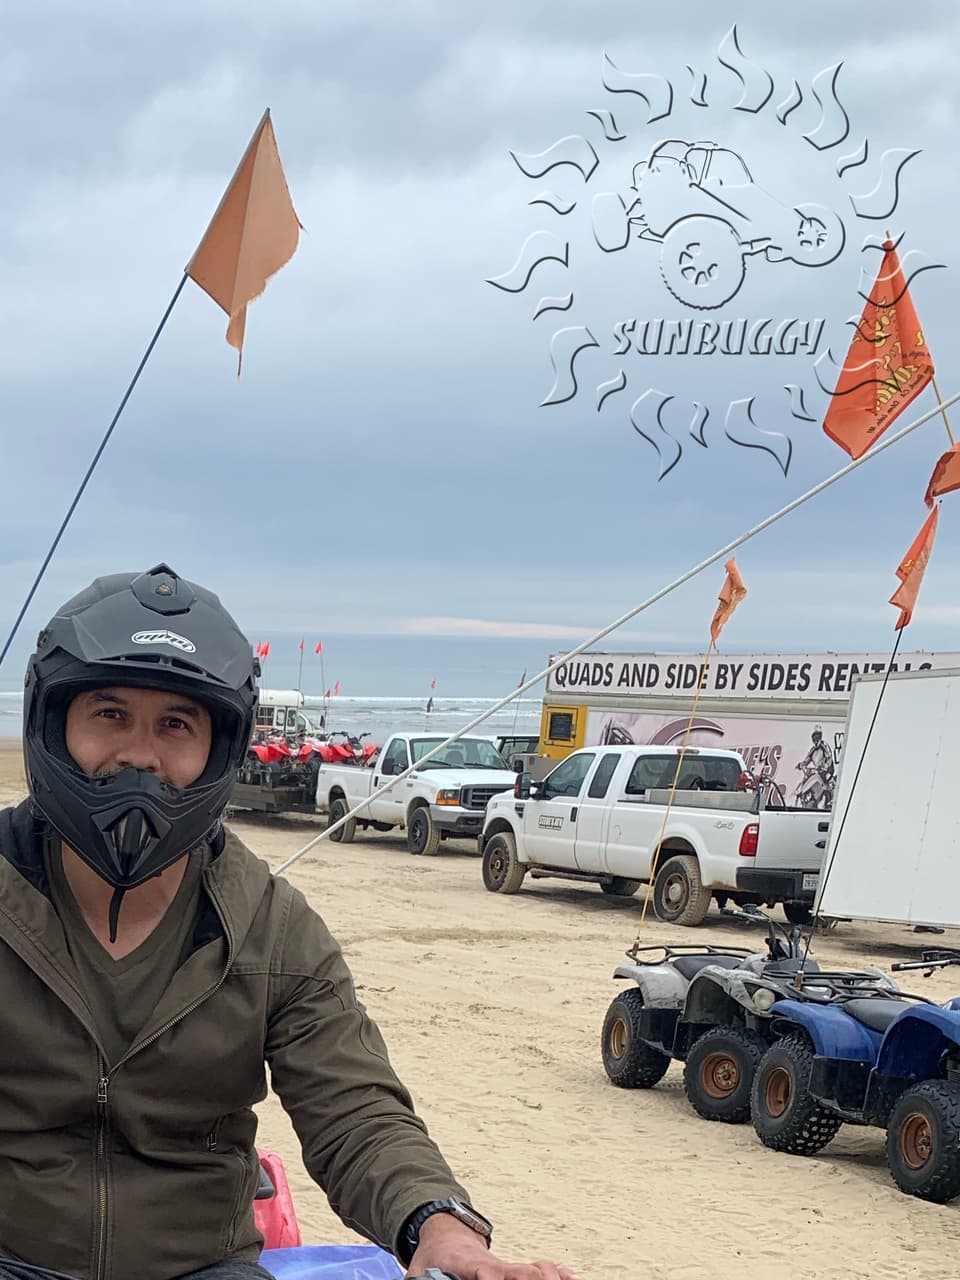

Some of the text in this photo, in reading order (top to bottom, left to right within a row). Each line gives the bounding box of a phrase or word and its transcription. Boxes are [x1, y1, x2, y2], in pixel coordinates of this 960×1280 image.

[555, 662, 614, 687] QUADS
[617, 663, 660, 688] AND
[664, 663, 710, 689] SIDE
[714, 664, 744, 690] BY
[746, 663, 812, 691] SIDES
